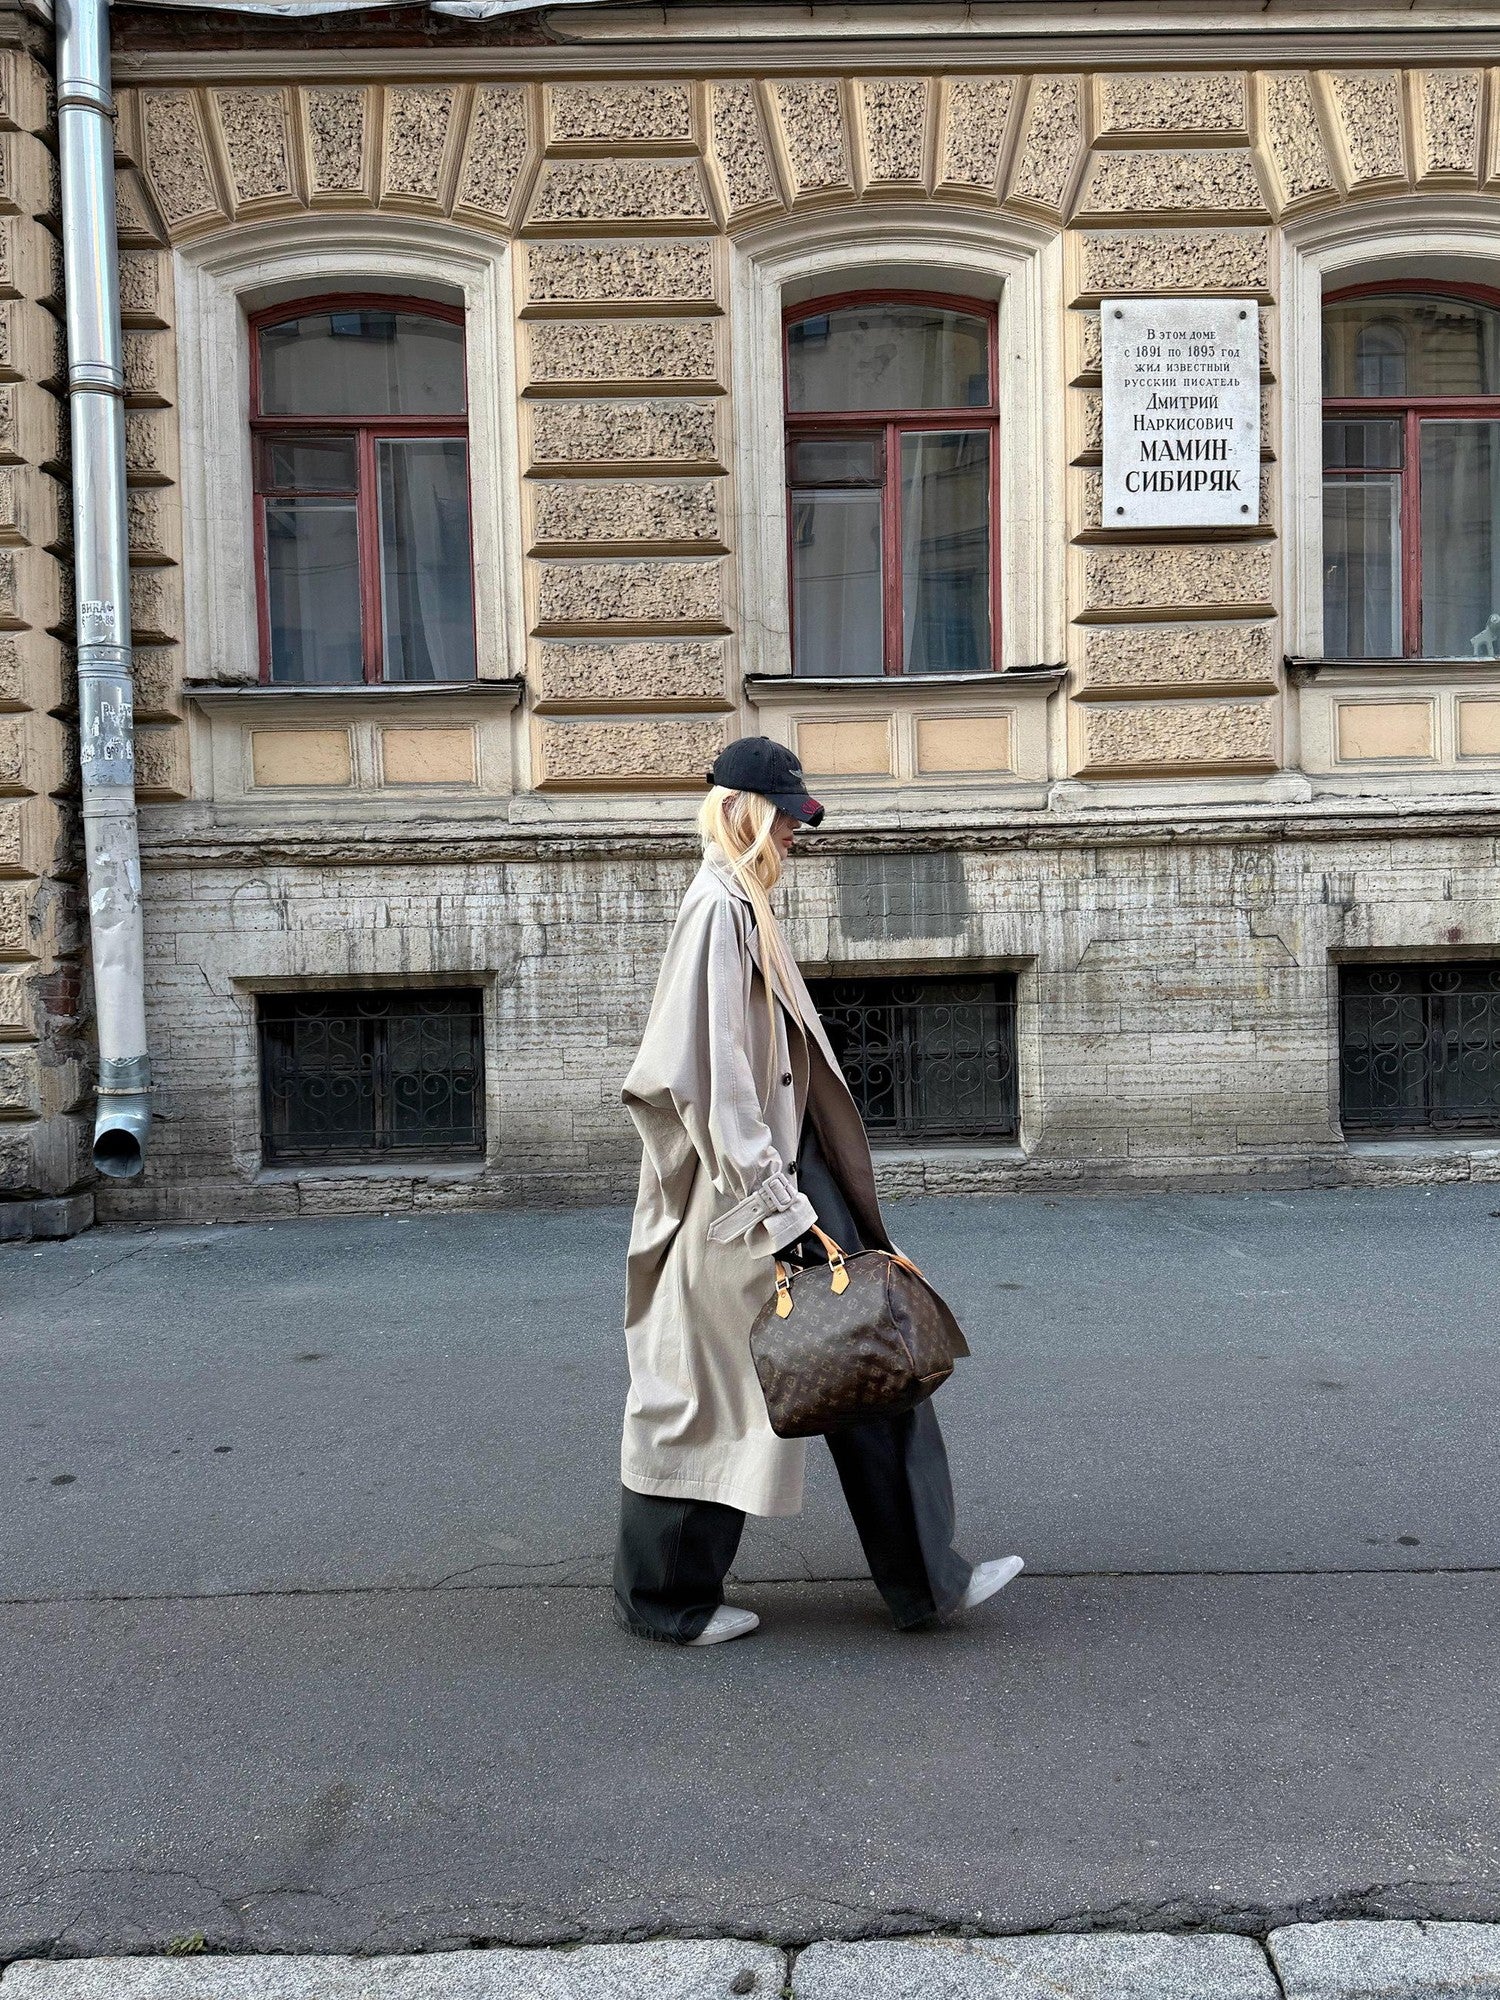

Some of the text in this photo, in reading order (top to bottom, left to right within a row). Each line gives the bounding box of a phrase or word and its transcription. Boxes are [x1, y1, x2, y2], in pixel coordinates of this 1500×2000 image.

[1136, 345, 1161, 358] 1891
[1188, 345, 1216, 358] 1893
[1139, 438, 1233, 462] МАМИН-
[1125, 469, 1242, 493] СИБИРЯК
